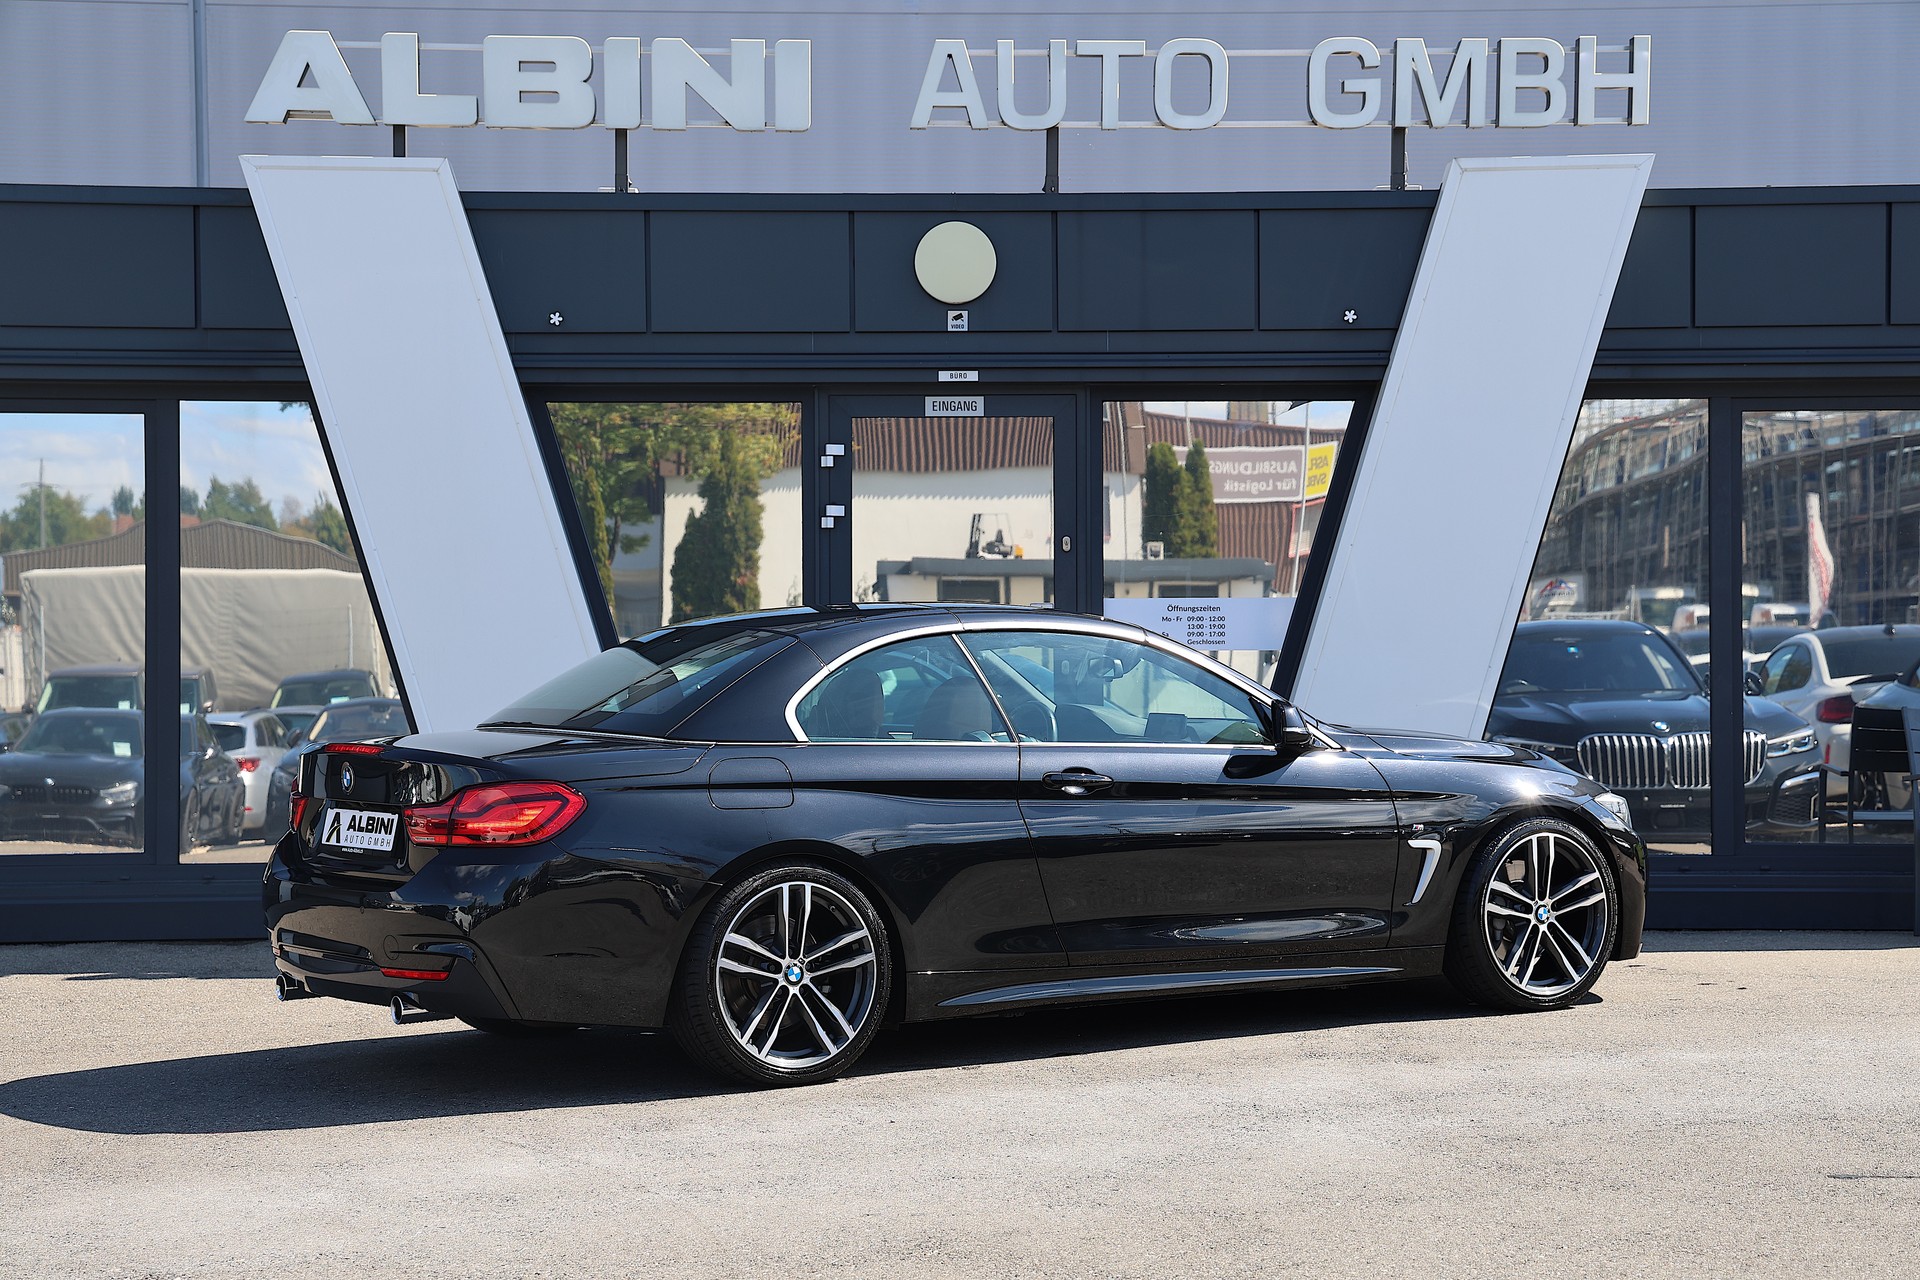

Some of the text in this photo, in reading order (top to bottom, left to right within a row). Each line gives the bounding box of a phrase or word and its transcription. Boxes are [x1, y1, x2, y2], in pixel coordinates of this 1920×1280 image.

[244, 29, 1652, 132] ALBINI AUTO GMBH
[932, 400, 978, 412] EINGANG
[1167, 604, 1221, 613] Öffnungszeiten
[347, 815, 395, 835] ALBINI
[344, 834, 392, 848] AUTO GMBH
